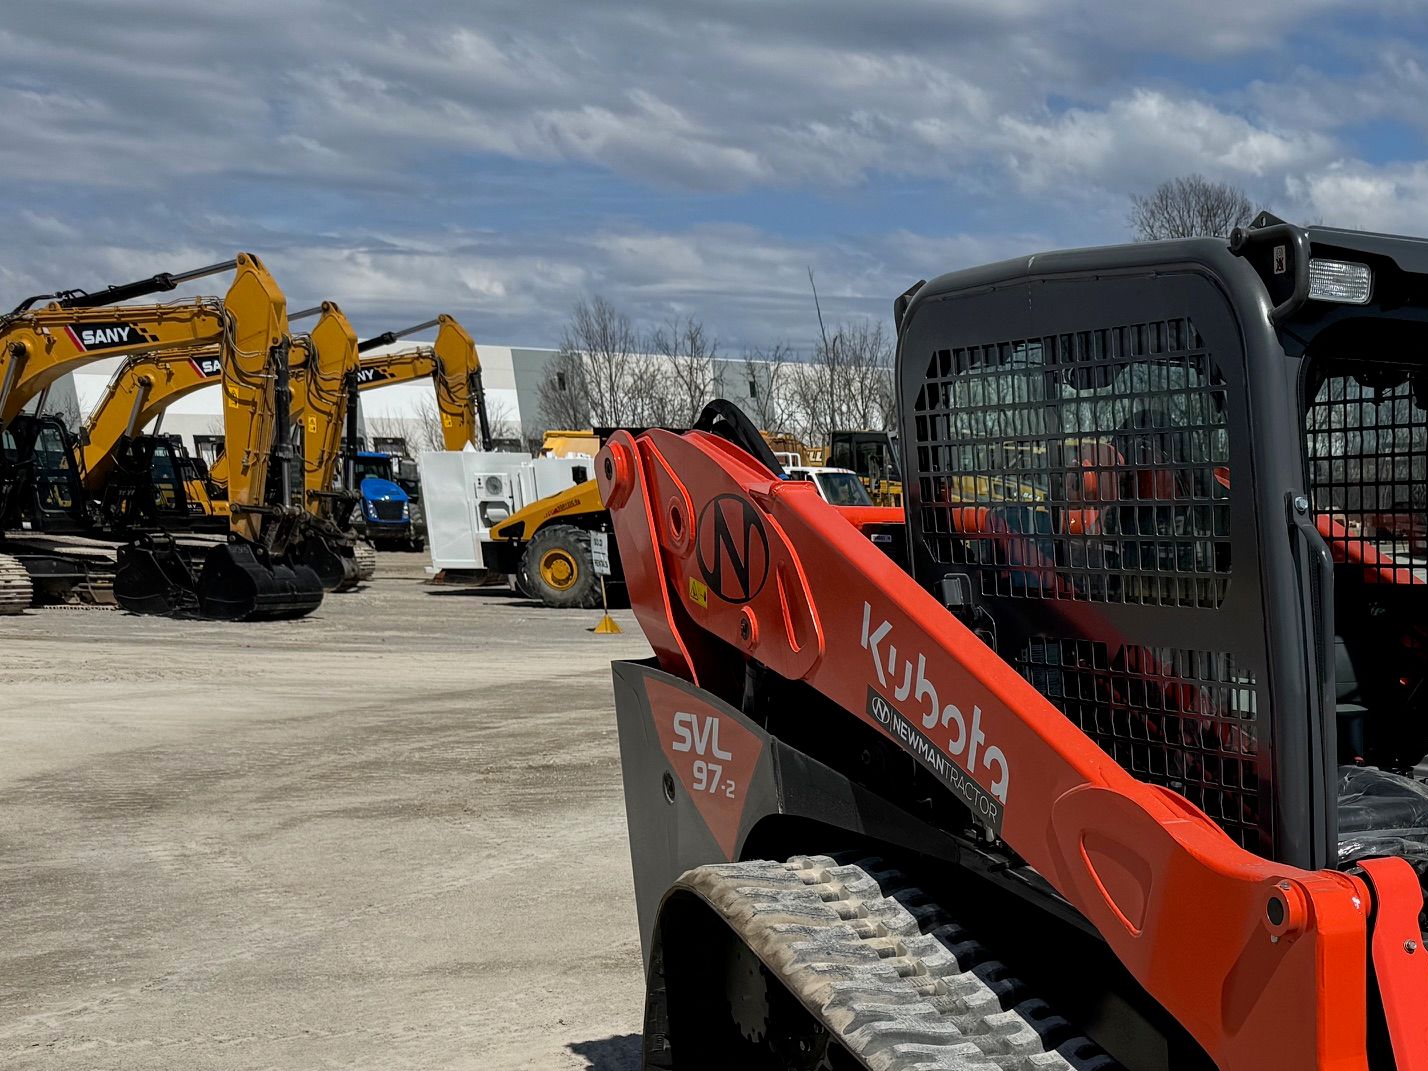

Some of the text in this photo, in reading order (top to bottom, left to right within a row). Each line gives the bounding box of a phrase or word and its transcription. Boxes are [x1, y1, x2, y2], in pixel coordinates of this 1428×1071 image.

[82, 327, 130, 345] SANY
[202, 360, 221, 373] SA
[357, 369, 374, 381] NY
[861, 601, 1009, 805] Kubota
[672, 711, 732, 761] SVL
[692, 760, 736, 799] 97-2
